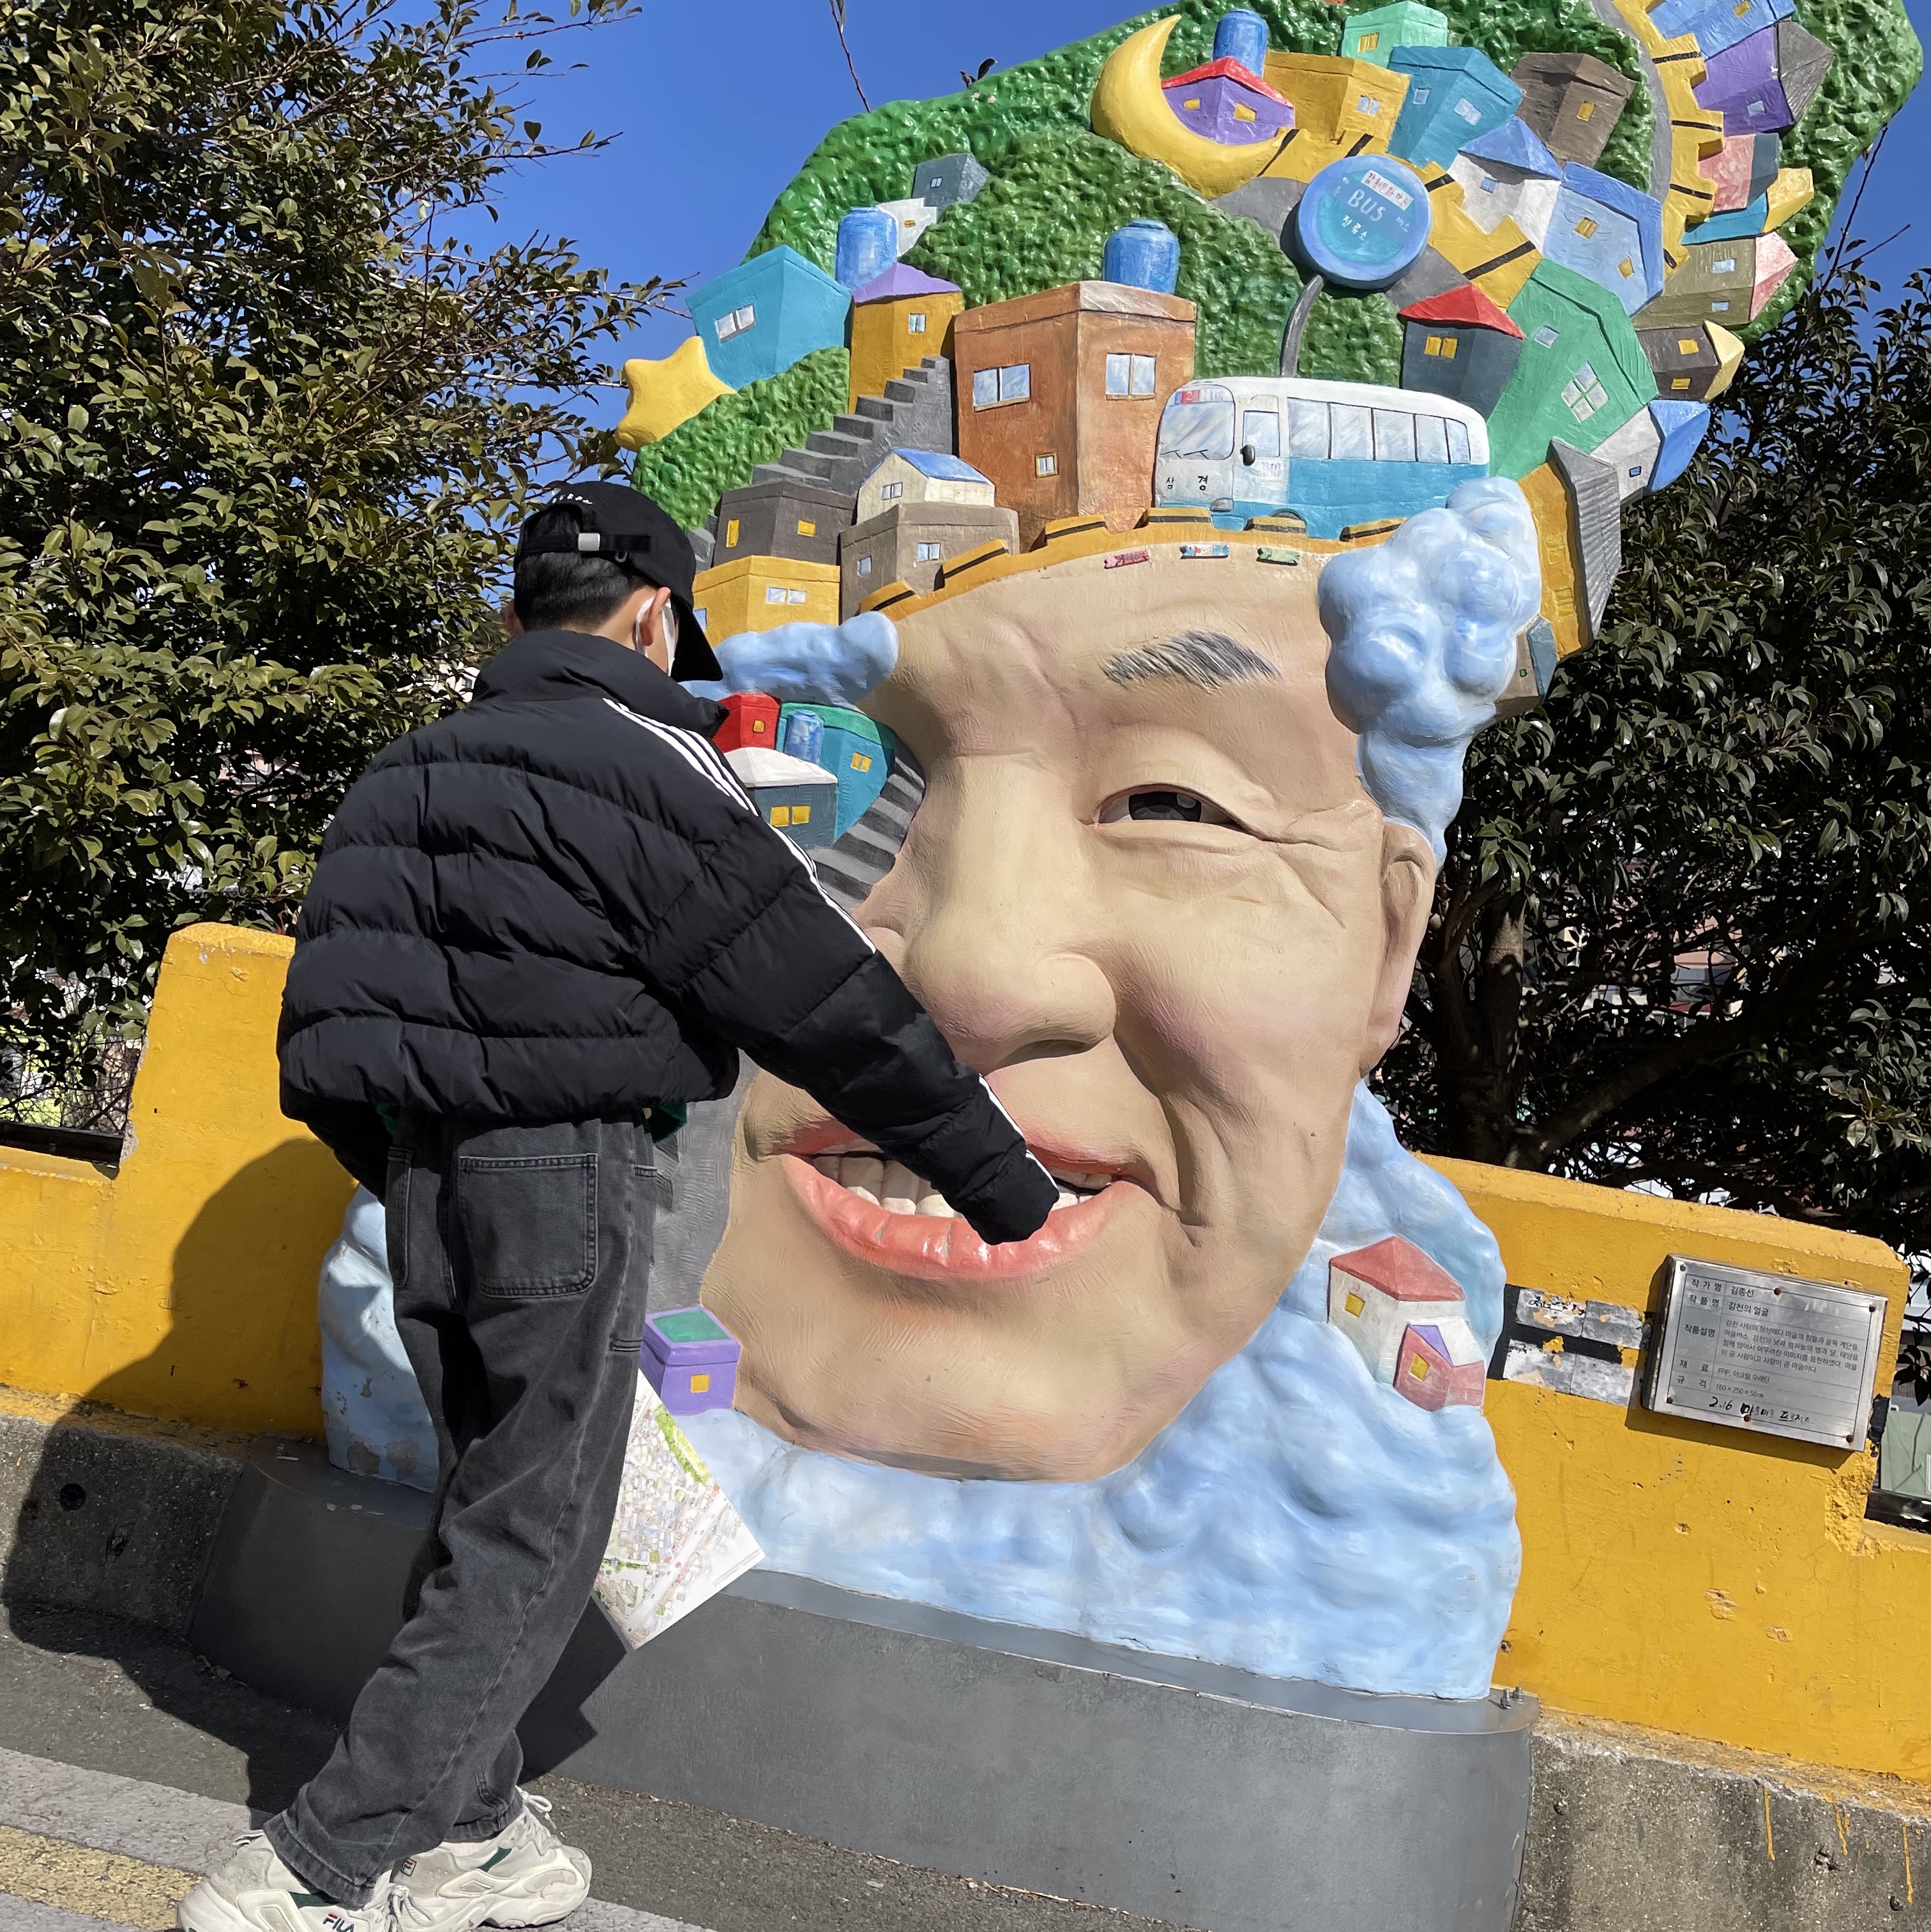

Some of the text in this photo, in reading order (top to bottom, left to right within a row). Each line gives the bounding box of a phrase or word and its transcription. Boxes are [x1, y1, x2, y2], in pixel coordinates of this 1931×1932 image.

[1347, 188, 1386, 222] BUS
[1342, 215, 1368, 241] 정류소
[1186, 391, 1193, 401] 2
[1730, 1286, 1753, 1297] 김종선
[1729, 1302, 1769, 1316] 감천의 얼굴
[1685, 1324, 1715, 1337] 작품설명
[1739, 1322, 1758, 1331] 사람의
[1785, 1330, 1804, 1340] 마을의
[1753, 1335, 1771, 1344] 감천의
[1815, 1346, 1827, 1355] 별과
[1737, 1351, 1761, 1362] 사람이고
[1762, 1357, 1782, 1366] 사람이
[1783, 1351, 1807, 1360] 이미지를
[322, 1912, 354, 1932] FILA
